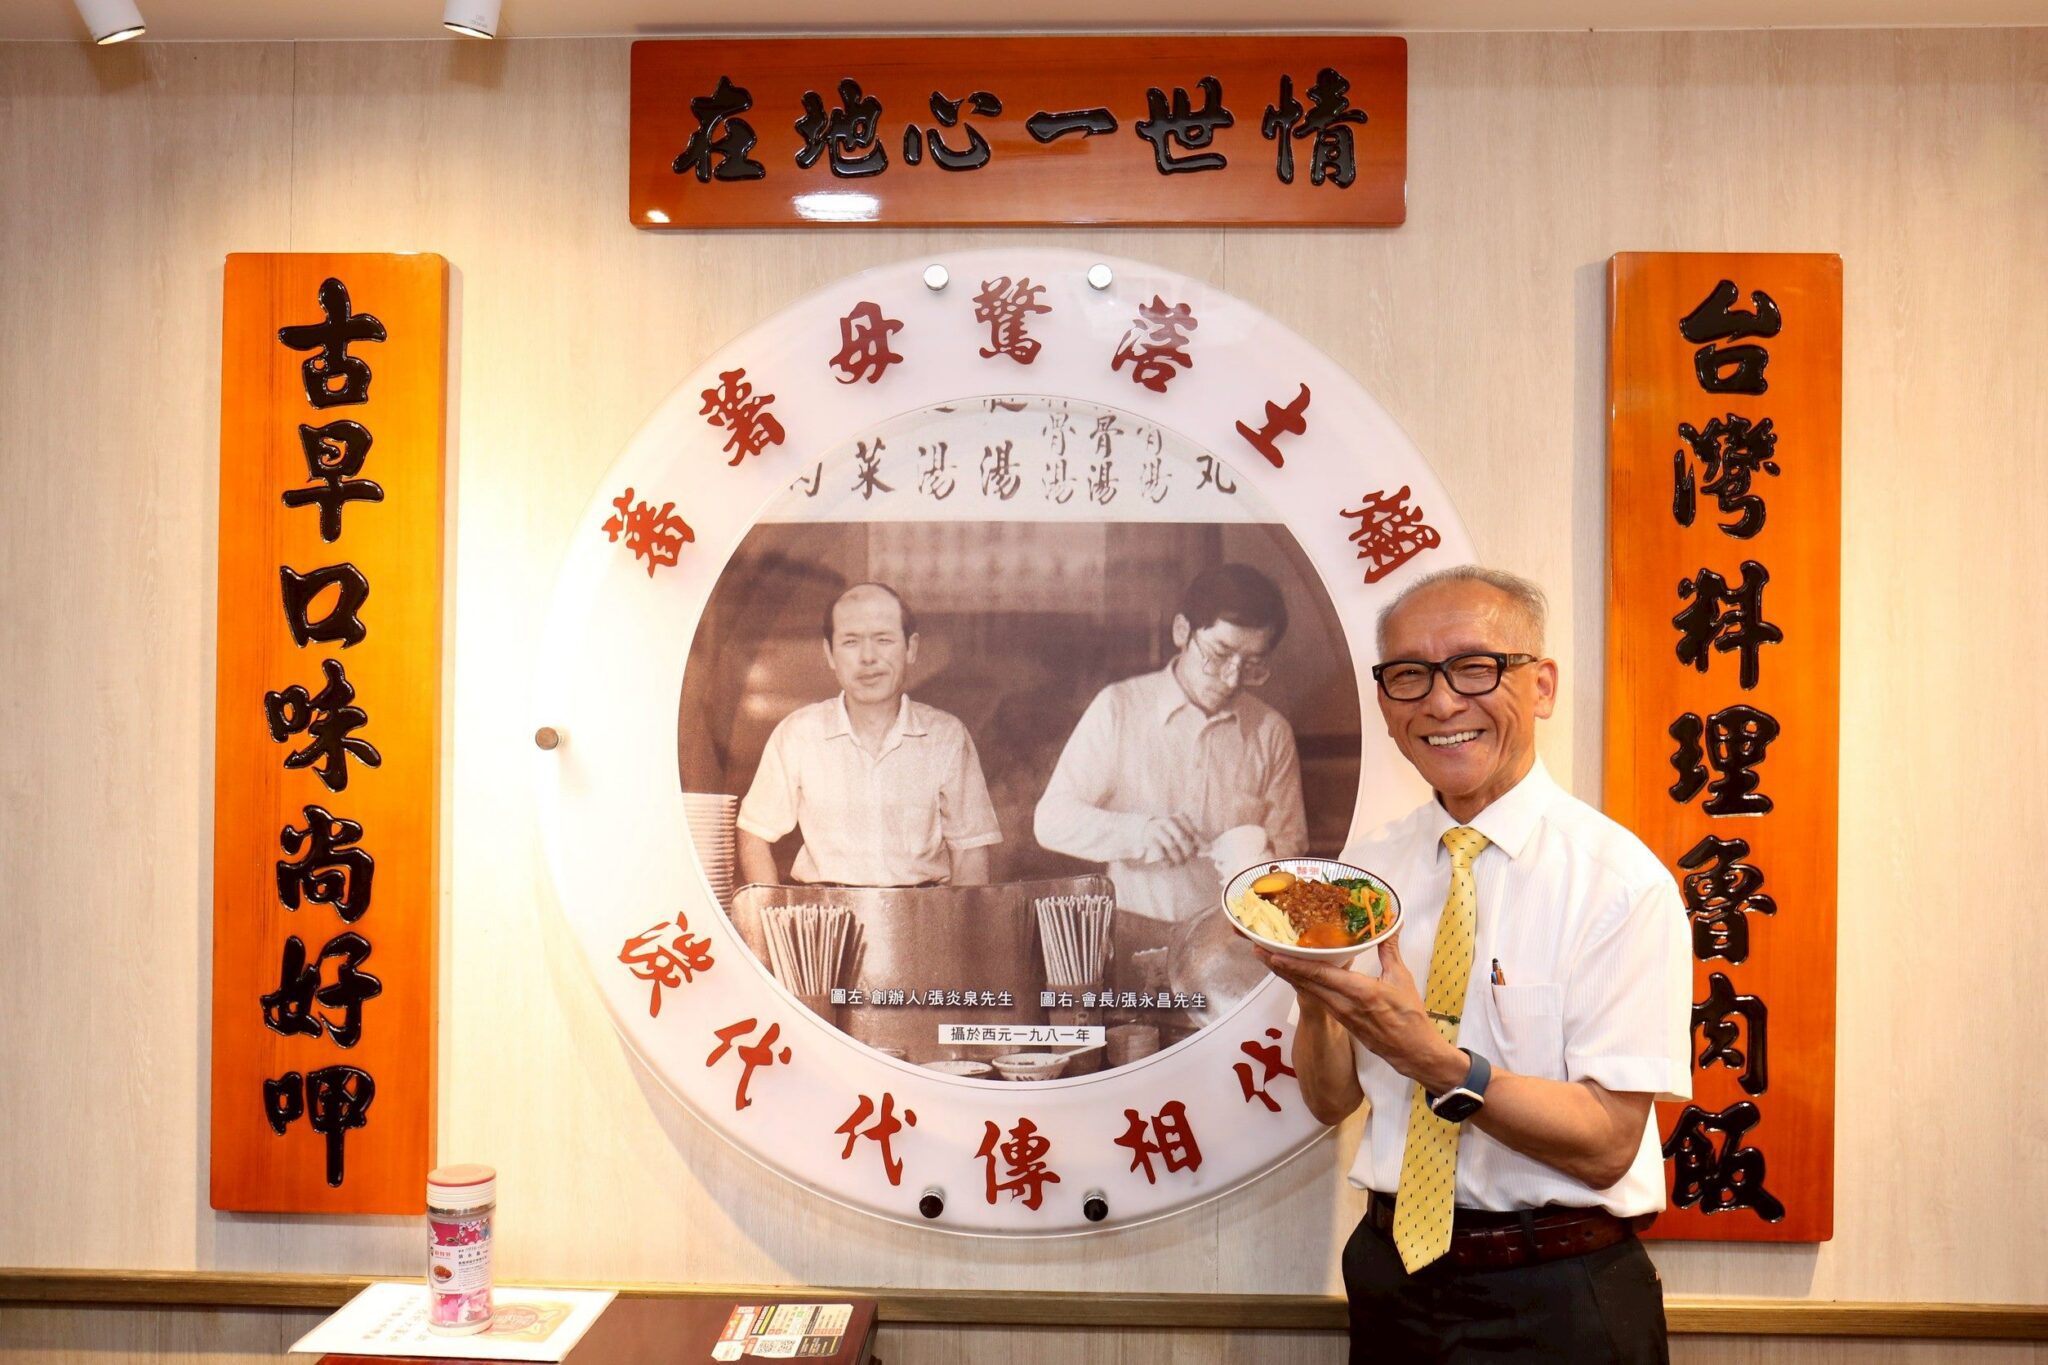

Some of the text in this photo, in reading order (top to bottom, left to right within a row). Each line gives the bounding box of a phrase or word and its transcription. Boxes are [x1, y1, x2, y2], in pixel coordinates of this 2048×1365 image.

[672, 67, 1368, 189] 在地心一世情
[260, 277, 388, 1188] 古早口味尚好呷
[1663, 279, 1785, 1224] 台灣料理魯肉飯
[830, 988, 1208, 1009] 圖左-創辦人/張炎泉先生 圖右-會長/張永昌先生
[950, 1026, 1091, 1045] 攝於西元一九八一年
